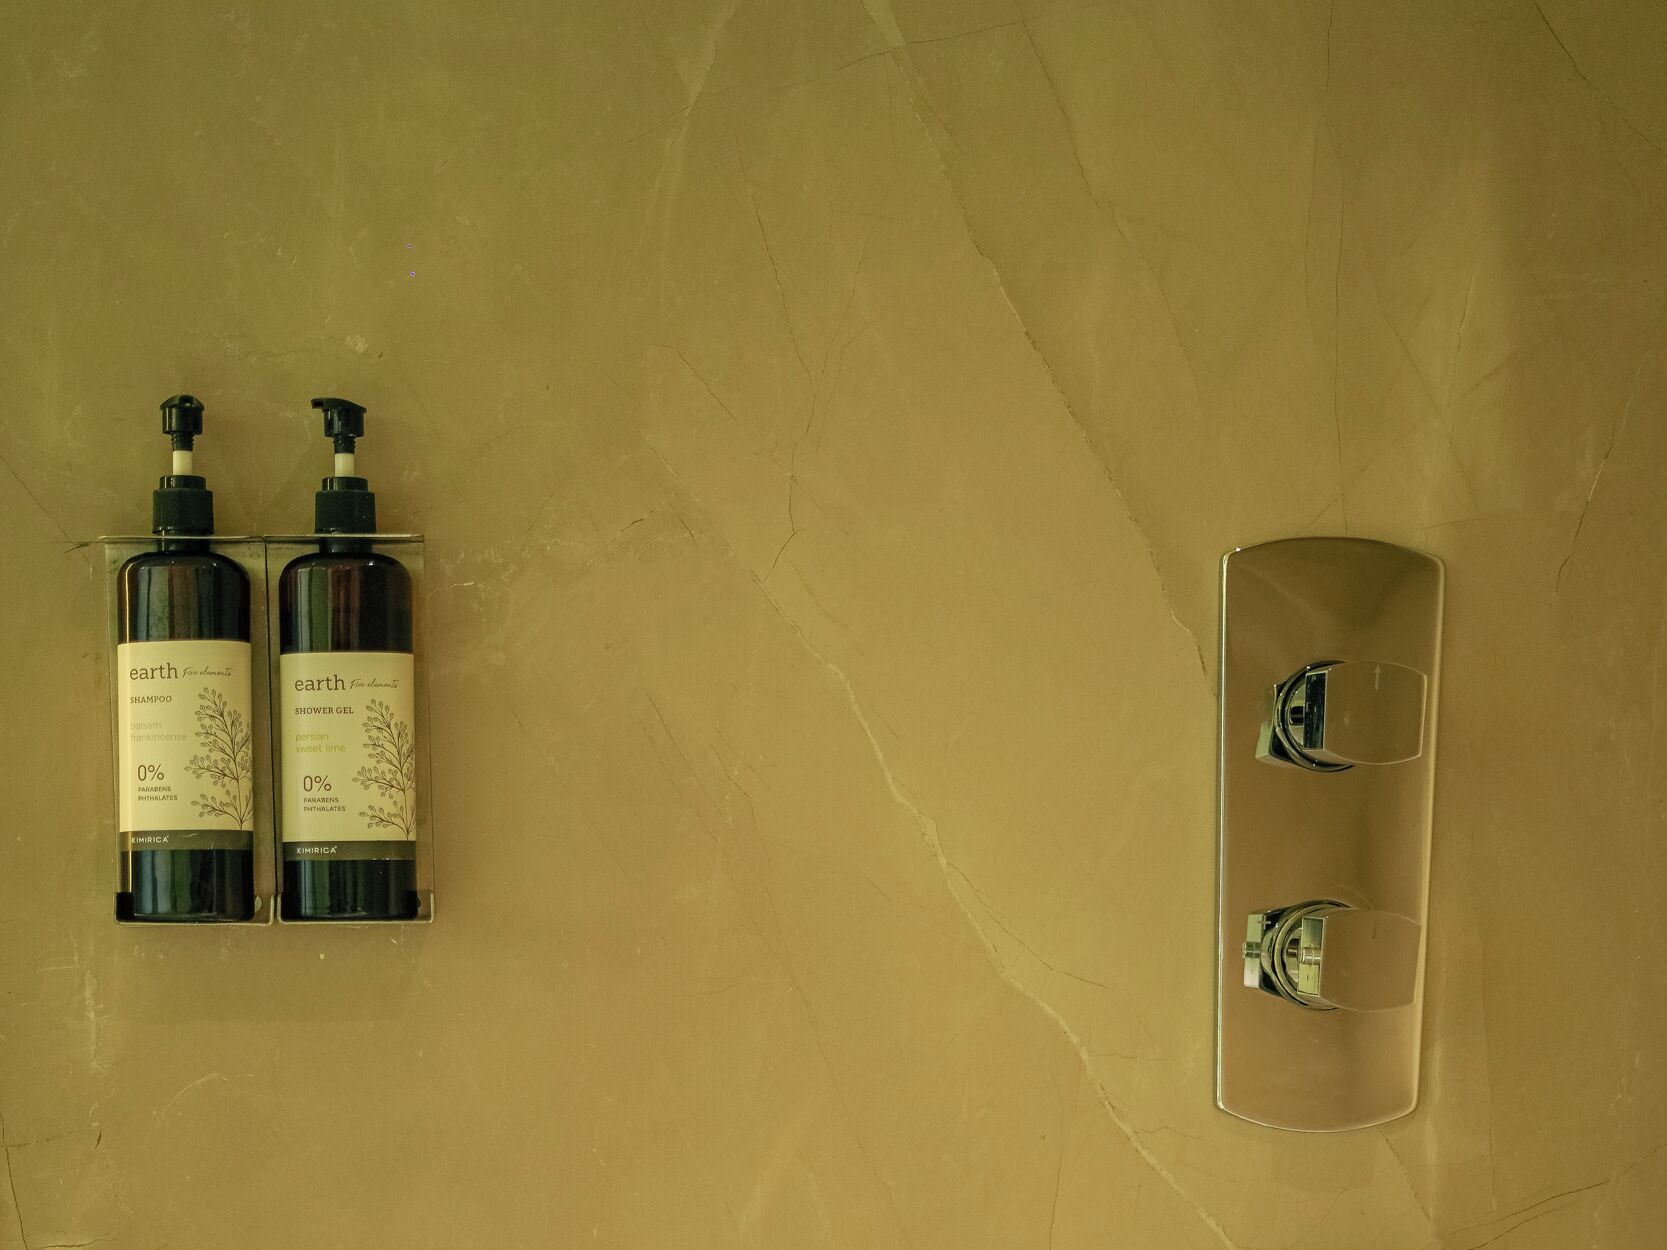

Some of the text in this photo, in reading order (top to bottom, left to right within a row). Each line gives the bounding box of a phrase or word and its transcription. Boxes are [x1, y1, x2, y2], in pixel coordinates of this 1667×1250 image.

[129, 662, 179, 680] earth
[199, 665, 233, 677] elements
[294, 674, 346, 692] earth
[366, 678, 401, 689] elements
[130, 695, 172, 704] SHAMPOO
[295, 706, 354, 715] SHOWER GEL
[130, 722, 162, 730] balsam
[130, 733, 189, 743] frankincense
[295, 733, 329, 743] persian
[295, 744, 347, 753] sweet lime
[137, 763, 165, 782] 0%
[303, 775, 332, 792] 0%
